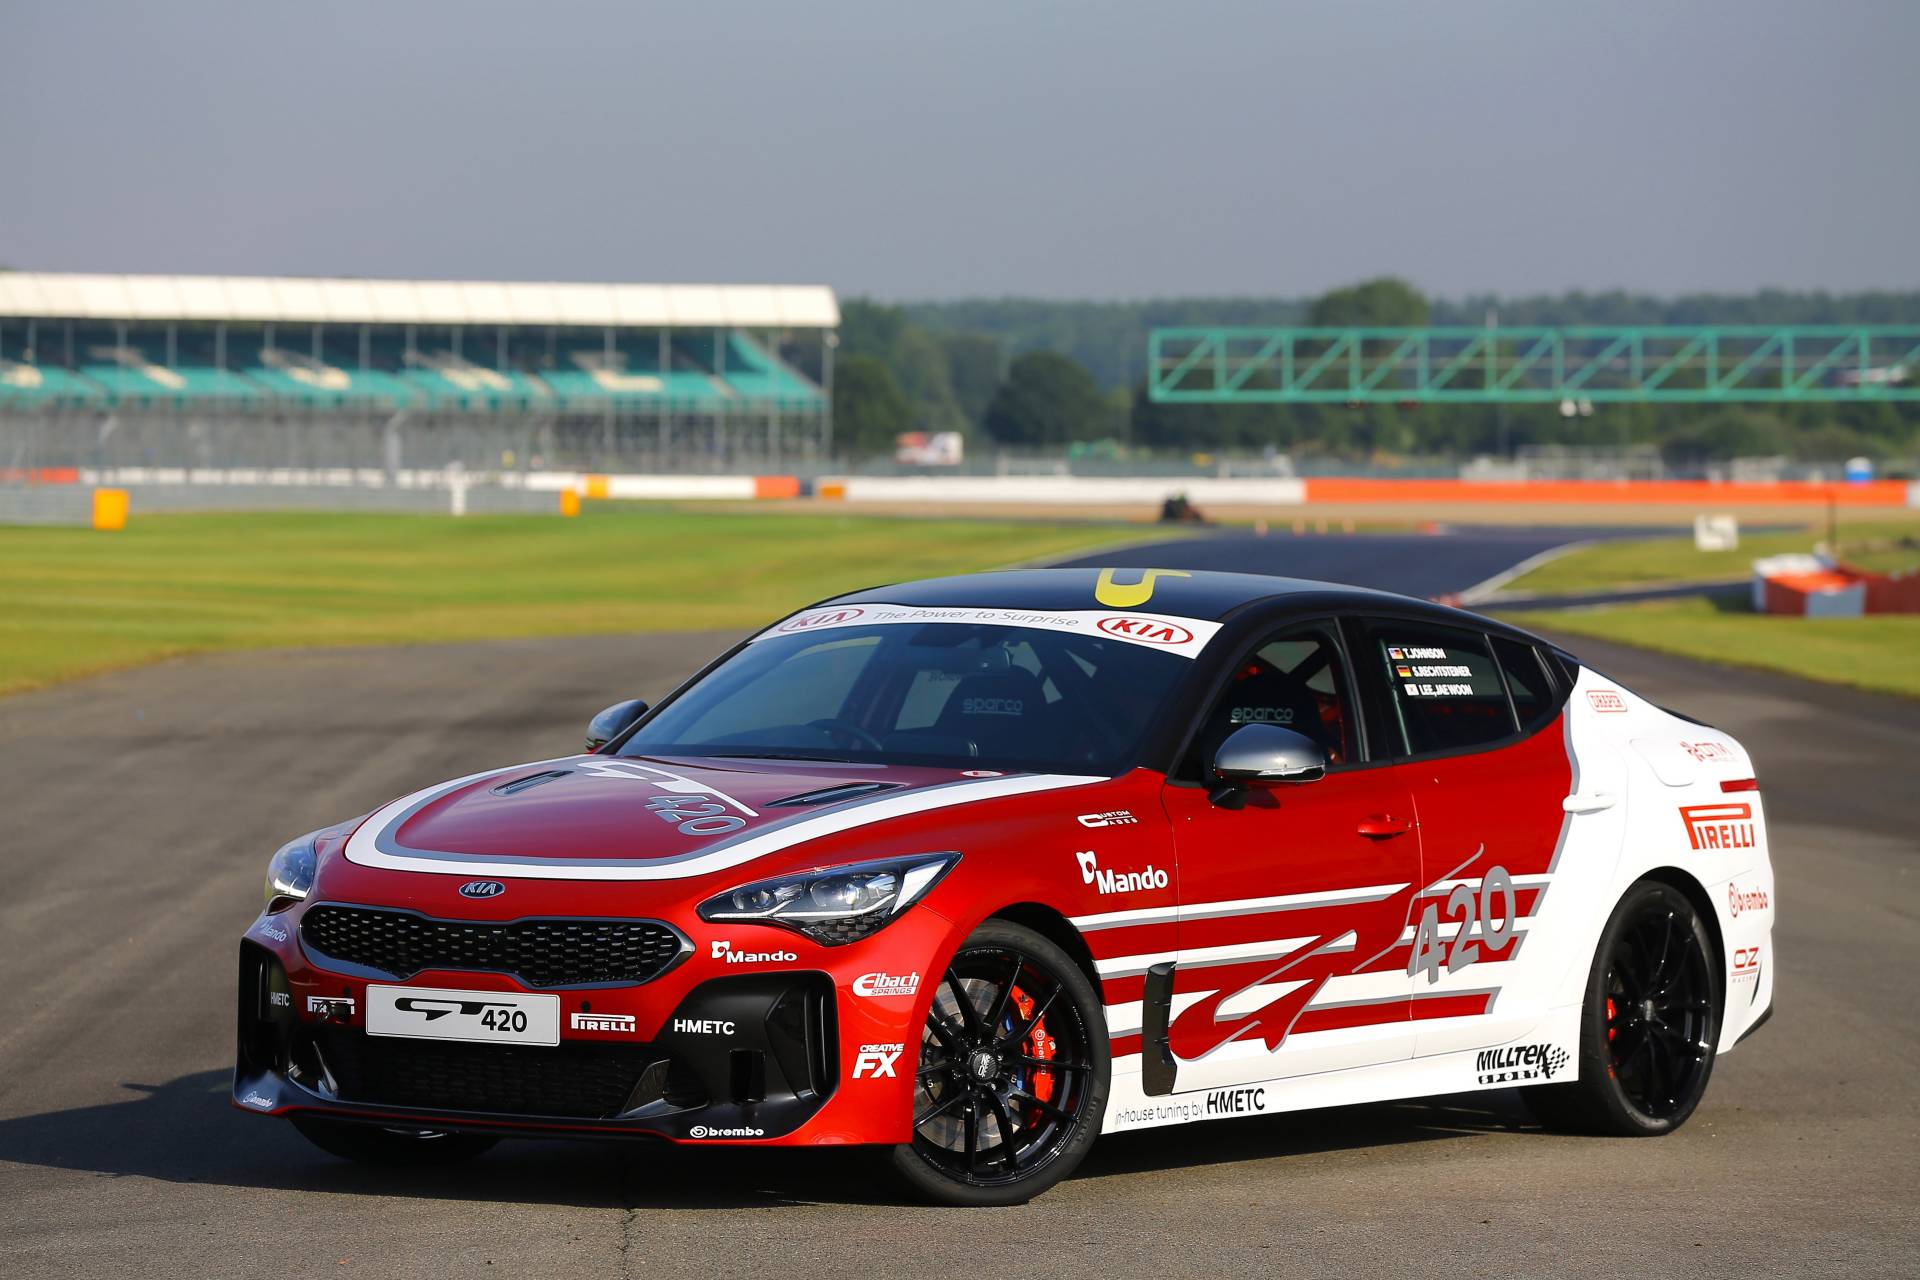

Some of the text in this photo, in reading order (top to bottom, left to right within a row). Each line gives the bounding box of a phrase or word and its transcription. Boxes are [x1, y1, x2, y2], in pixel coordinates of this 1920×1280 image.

[873, 610, 1080, 627] The Power to Surprise
[1111, 619, 1175, 642] KIA
[962, 697, 1023, 713] sparco
[1230, 705, 1294, 722] sparco
[643, 795, 747, 837] 420
[1678, 802, 1756, 850] PIRELLI
[1096, 864, 1169, 895] Mando
[1737, 887, 1769, 912] brembo
[1407, 865, 1516, 985] 420
[726, 950, 799, 964] Mando
[1733, 946, 1760, 969] OZ
[852, 971, 920, 997] Eibach
[870, 987, 913, 996] SPRINGS
[480, 1009, 528, 1033] 420
[570, 1012, 636, 1033] PIRELLI
[673, 1018, 735, 1036] HMETC
[859, 1043, 905, 1053] CREATIVE
[851, 1051, 903, 1079] FX
[1480, 1069, 1537, 1085] SPORT
[1114, 1087, 1266, 1126] in-house tuning by HMETC
[708, 1126, 765, 1137] brembo
